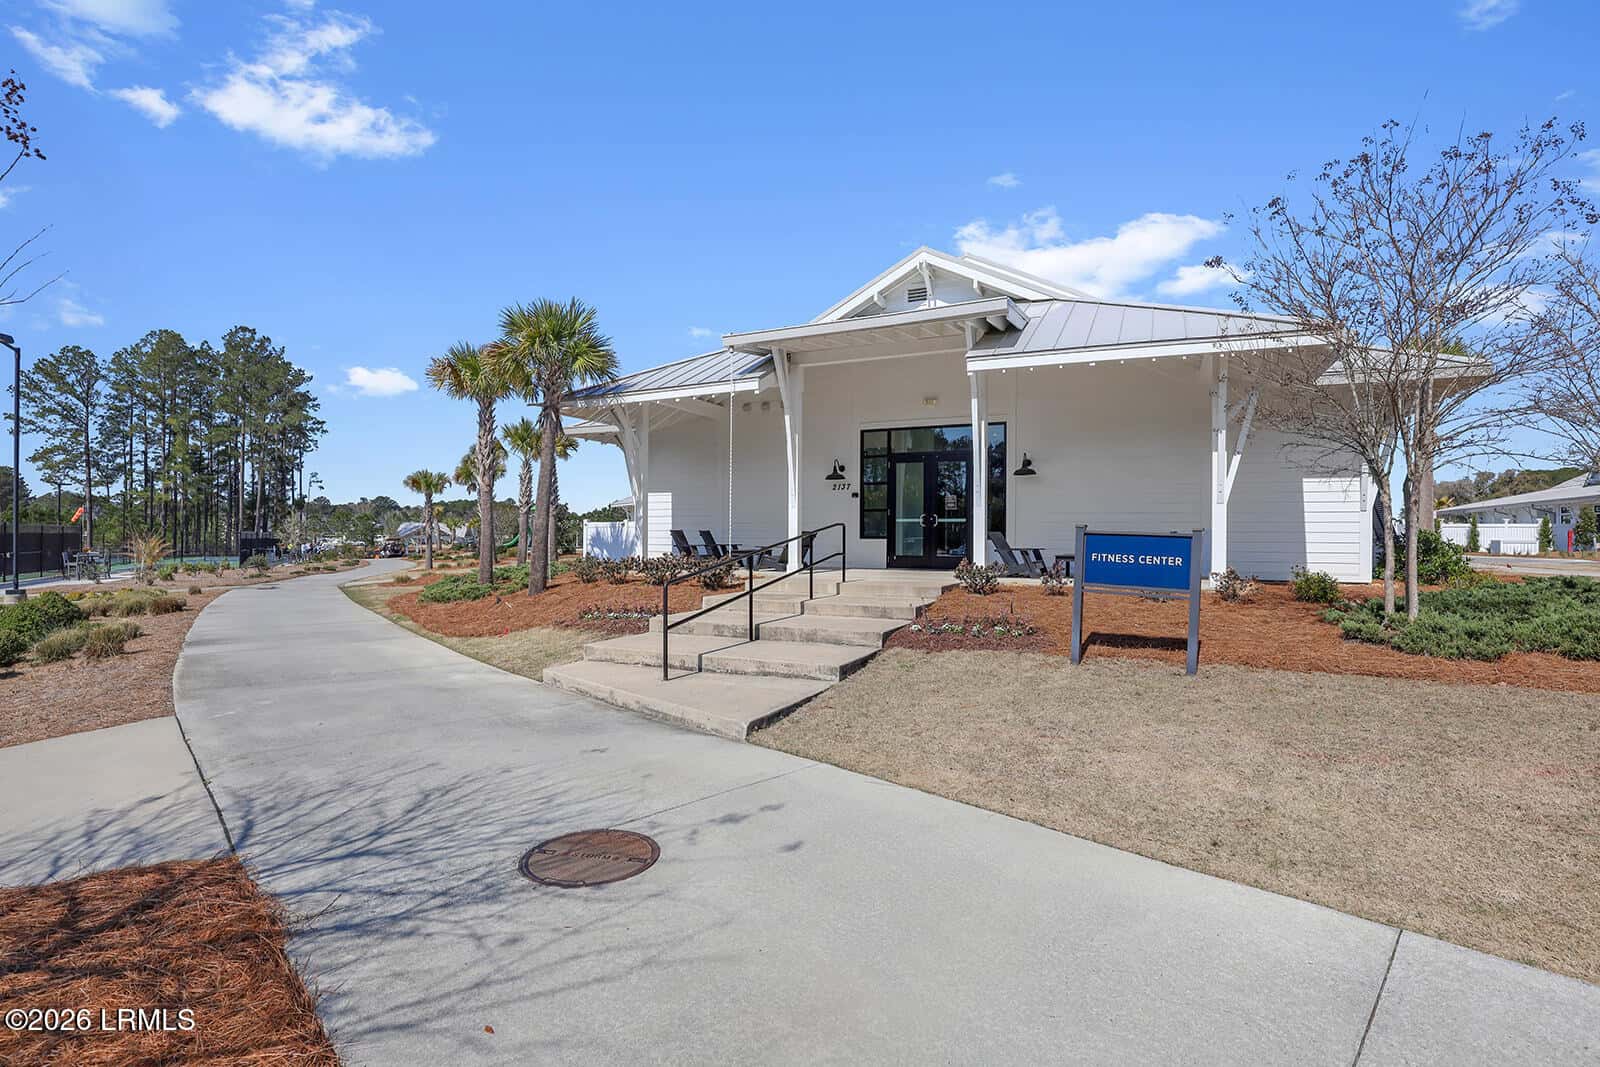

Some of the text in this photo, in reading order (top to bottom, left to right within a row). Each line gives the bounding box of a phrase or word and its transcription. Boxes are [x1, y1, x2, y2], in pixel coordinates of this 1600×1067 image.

[832, 483, 851, 491] 2137
[1091, 552, 1183, 566] FITNESS CENTER
